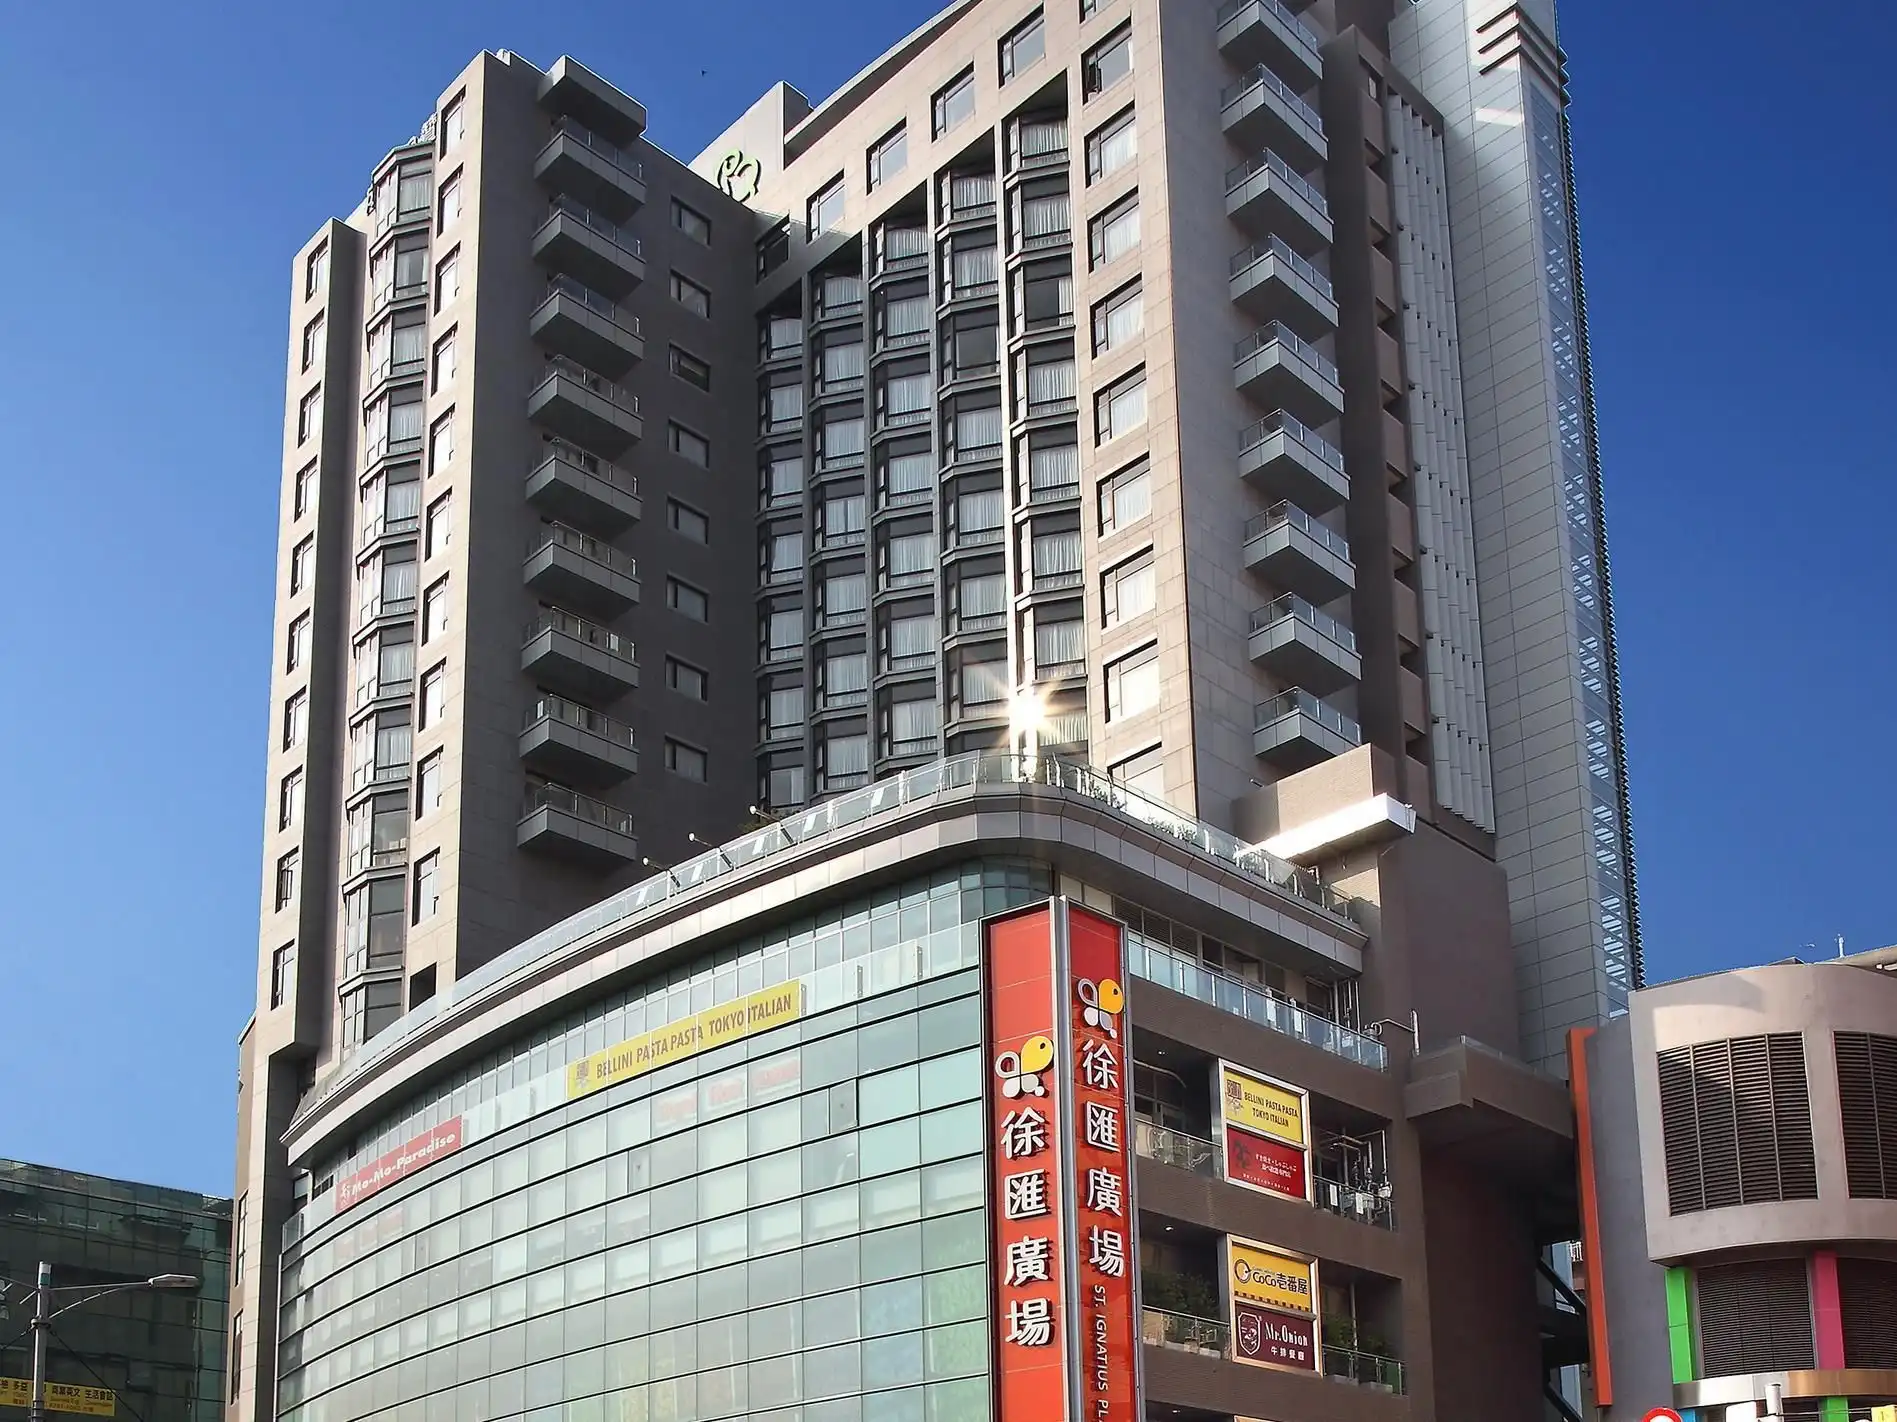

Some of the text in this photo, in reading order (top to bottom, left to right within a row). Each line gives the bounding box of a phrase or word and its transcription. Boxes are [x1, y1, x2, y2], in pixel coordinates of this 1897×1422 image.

[596, 1051, 633, 1080] BELLINI
[636, 1038, 668, 1064] PASTA
[670, 1024, 704, 1051] PASTA
[709, 1010, 745, 1037] TOKYO
[747, 993, 792, 1024] ITALIAN
[1244, 1092, 1299, 1118] BELLINI PASTA PASTA
[1252, 1107, 1289, 1128] TOKYO ITALIAN
[351, 1133, 456, 1196] Mo-Mo-Paradise
[1082, 1038, 1125, 1279] 徐匯廣場
[1000, 1106, 1053, 1347] 徐匯廣場
[1094, 1284, 1109, 1422] ST. IGNATIUS PL
[1265, 1322, 1308, 1347] Mr.Onion
